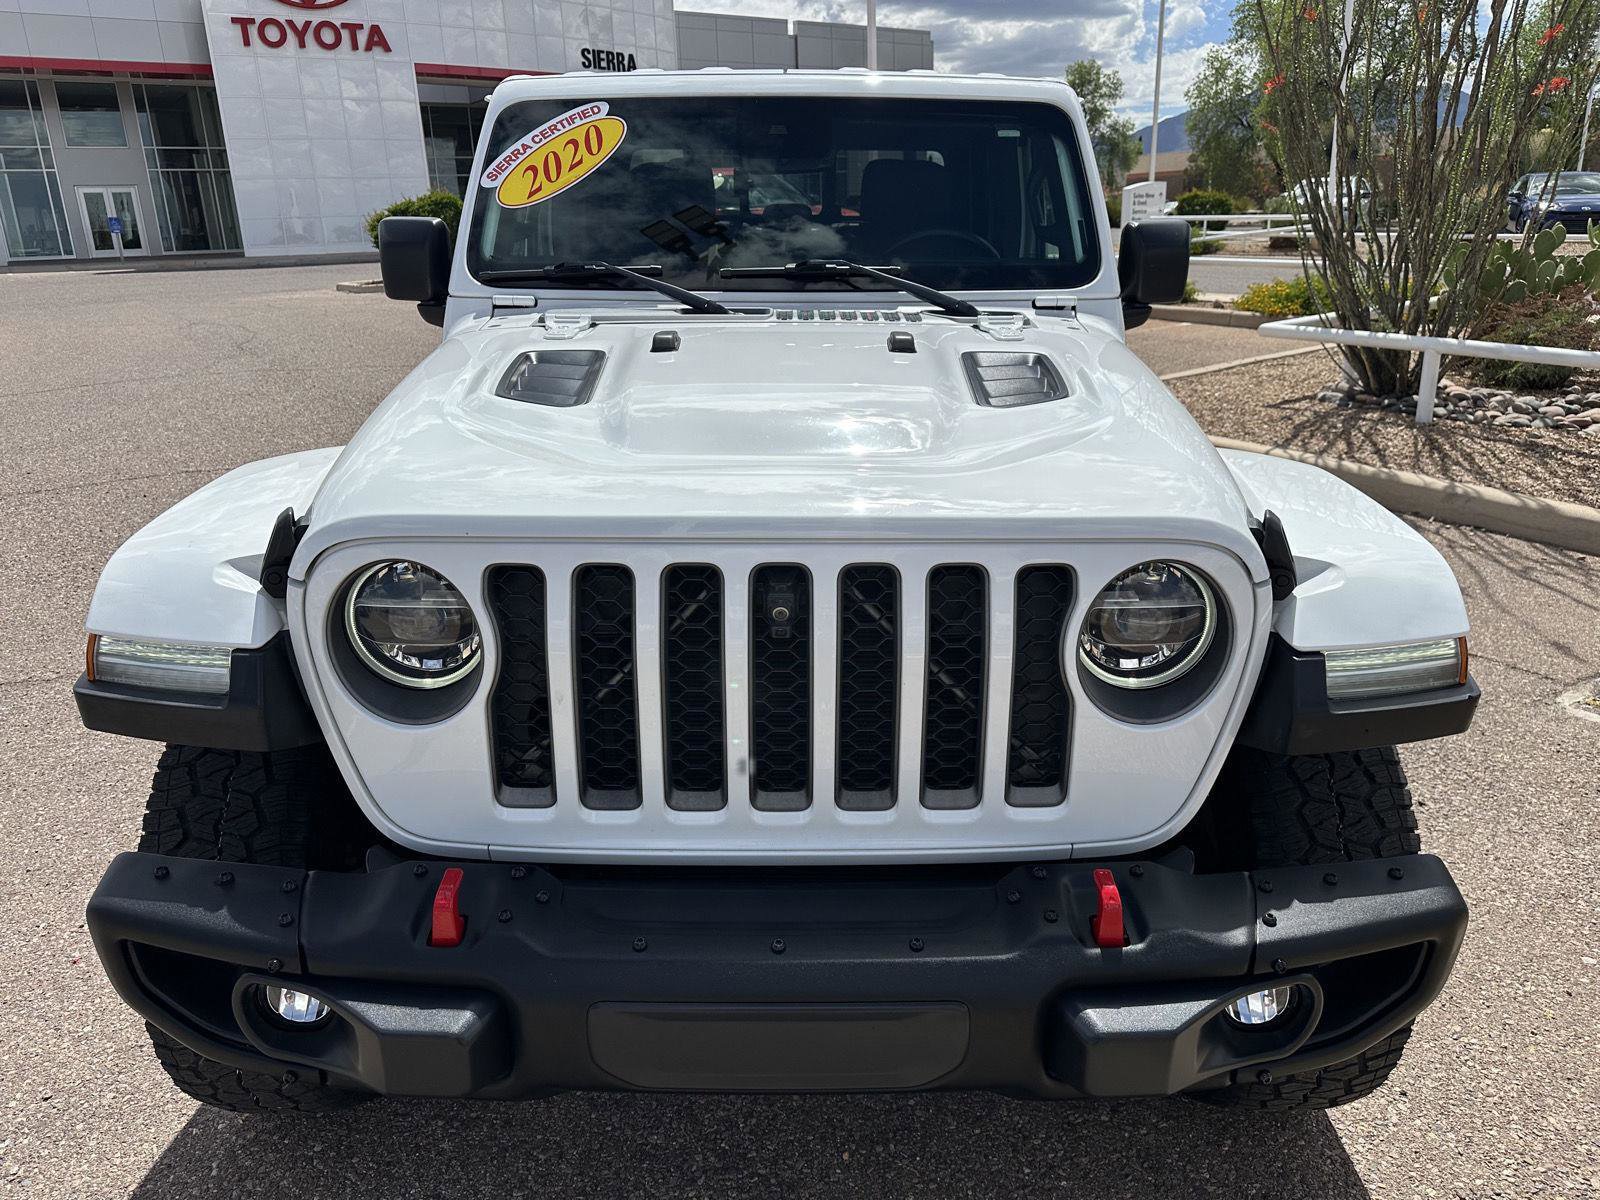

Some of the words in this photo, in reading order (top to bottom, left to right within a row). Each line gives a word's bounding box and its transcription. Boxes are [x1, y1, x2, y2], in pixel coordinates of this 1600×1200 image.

[230, 16, 392, 53] TOYOTA
[580, 47, 637, 72] SIERRA
[486, 143, 533, 182] SIERRA
[531, 104, 602, 145] CERTIFIED
[522, 124, 604, 200] 2020
